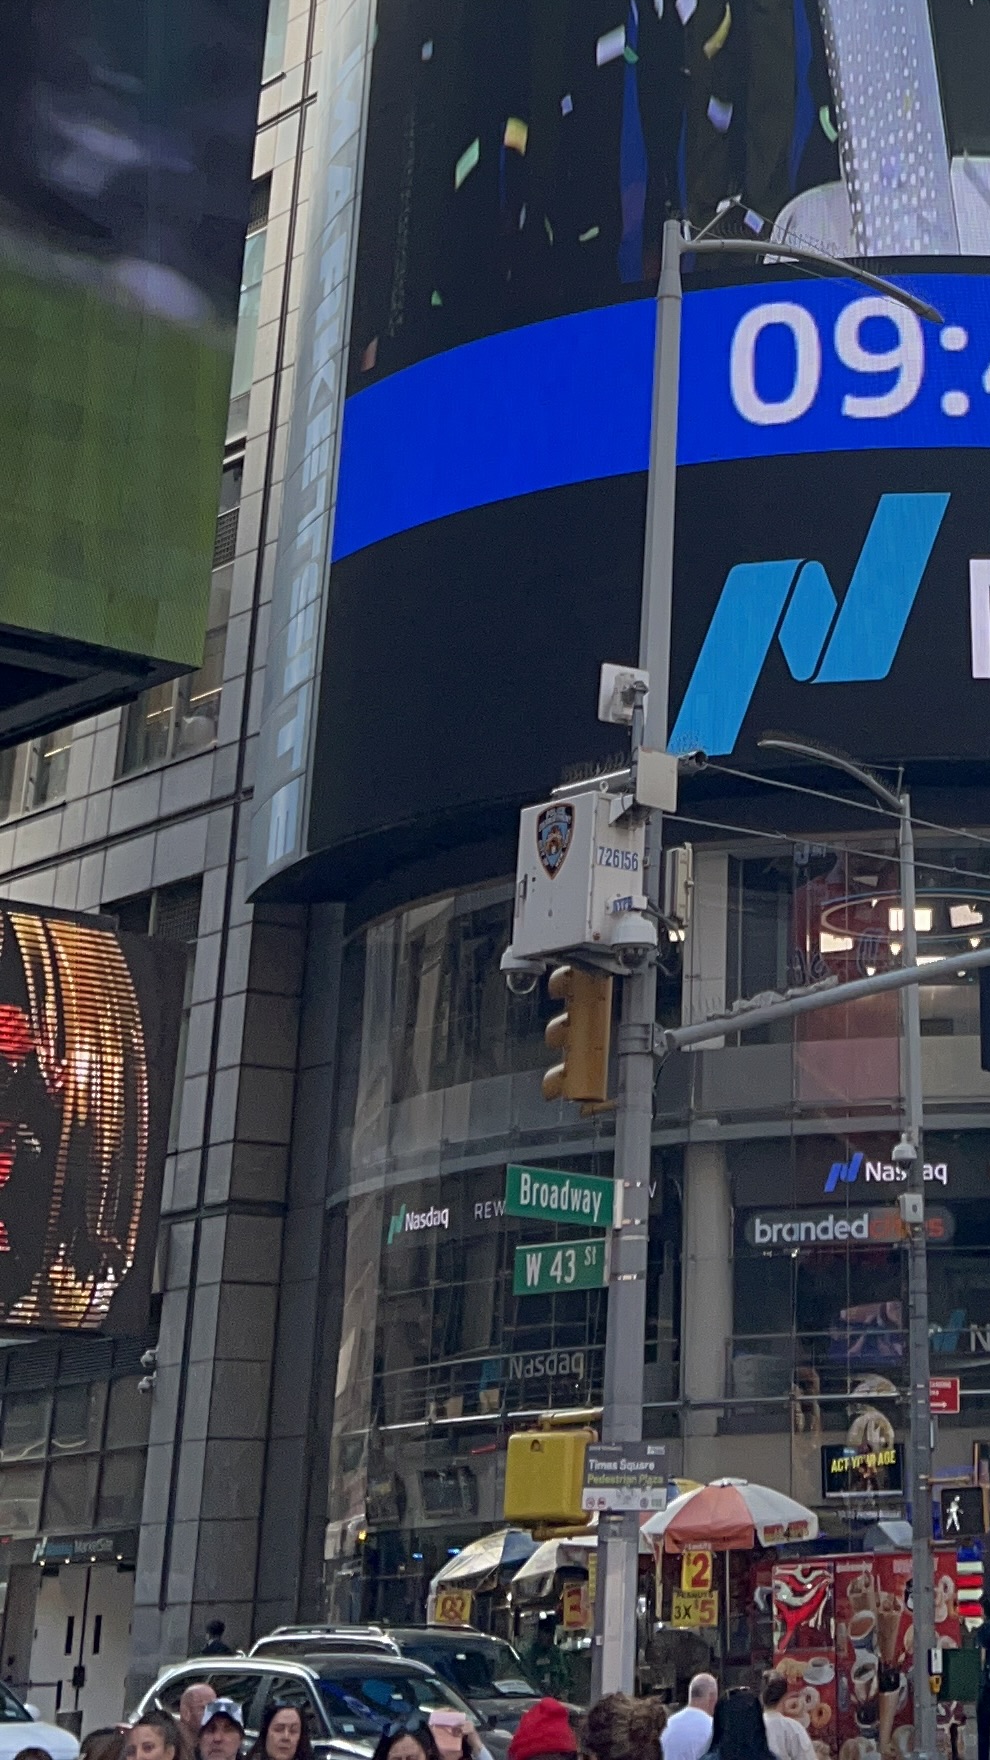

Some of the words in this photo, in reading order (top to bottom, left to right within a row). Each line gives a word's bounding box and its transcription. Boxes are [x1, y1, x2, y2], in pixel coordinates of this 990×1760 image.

[598, 845, 640, 872] 726156
[865, 1161, 948, 1185] Nasaq
[519, 1172, 603, 1223] Broadway
[404, 1206, 450, 1233] Nasdaq
[525, 1251, 542, 1288] W
[550, 1248, 576, 1285] 43
[584, 1245, 597, 1267] St
[508, 1350, 585, 1381] Nasdaq
[588, 1458, 618, 1471] Times
[619, 1458, 656, 1472] Square
[831, 1458, 850, 1474] ACT
